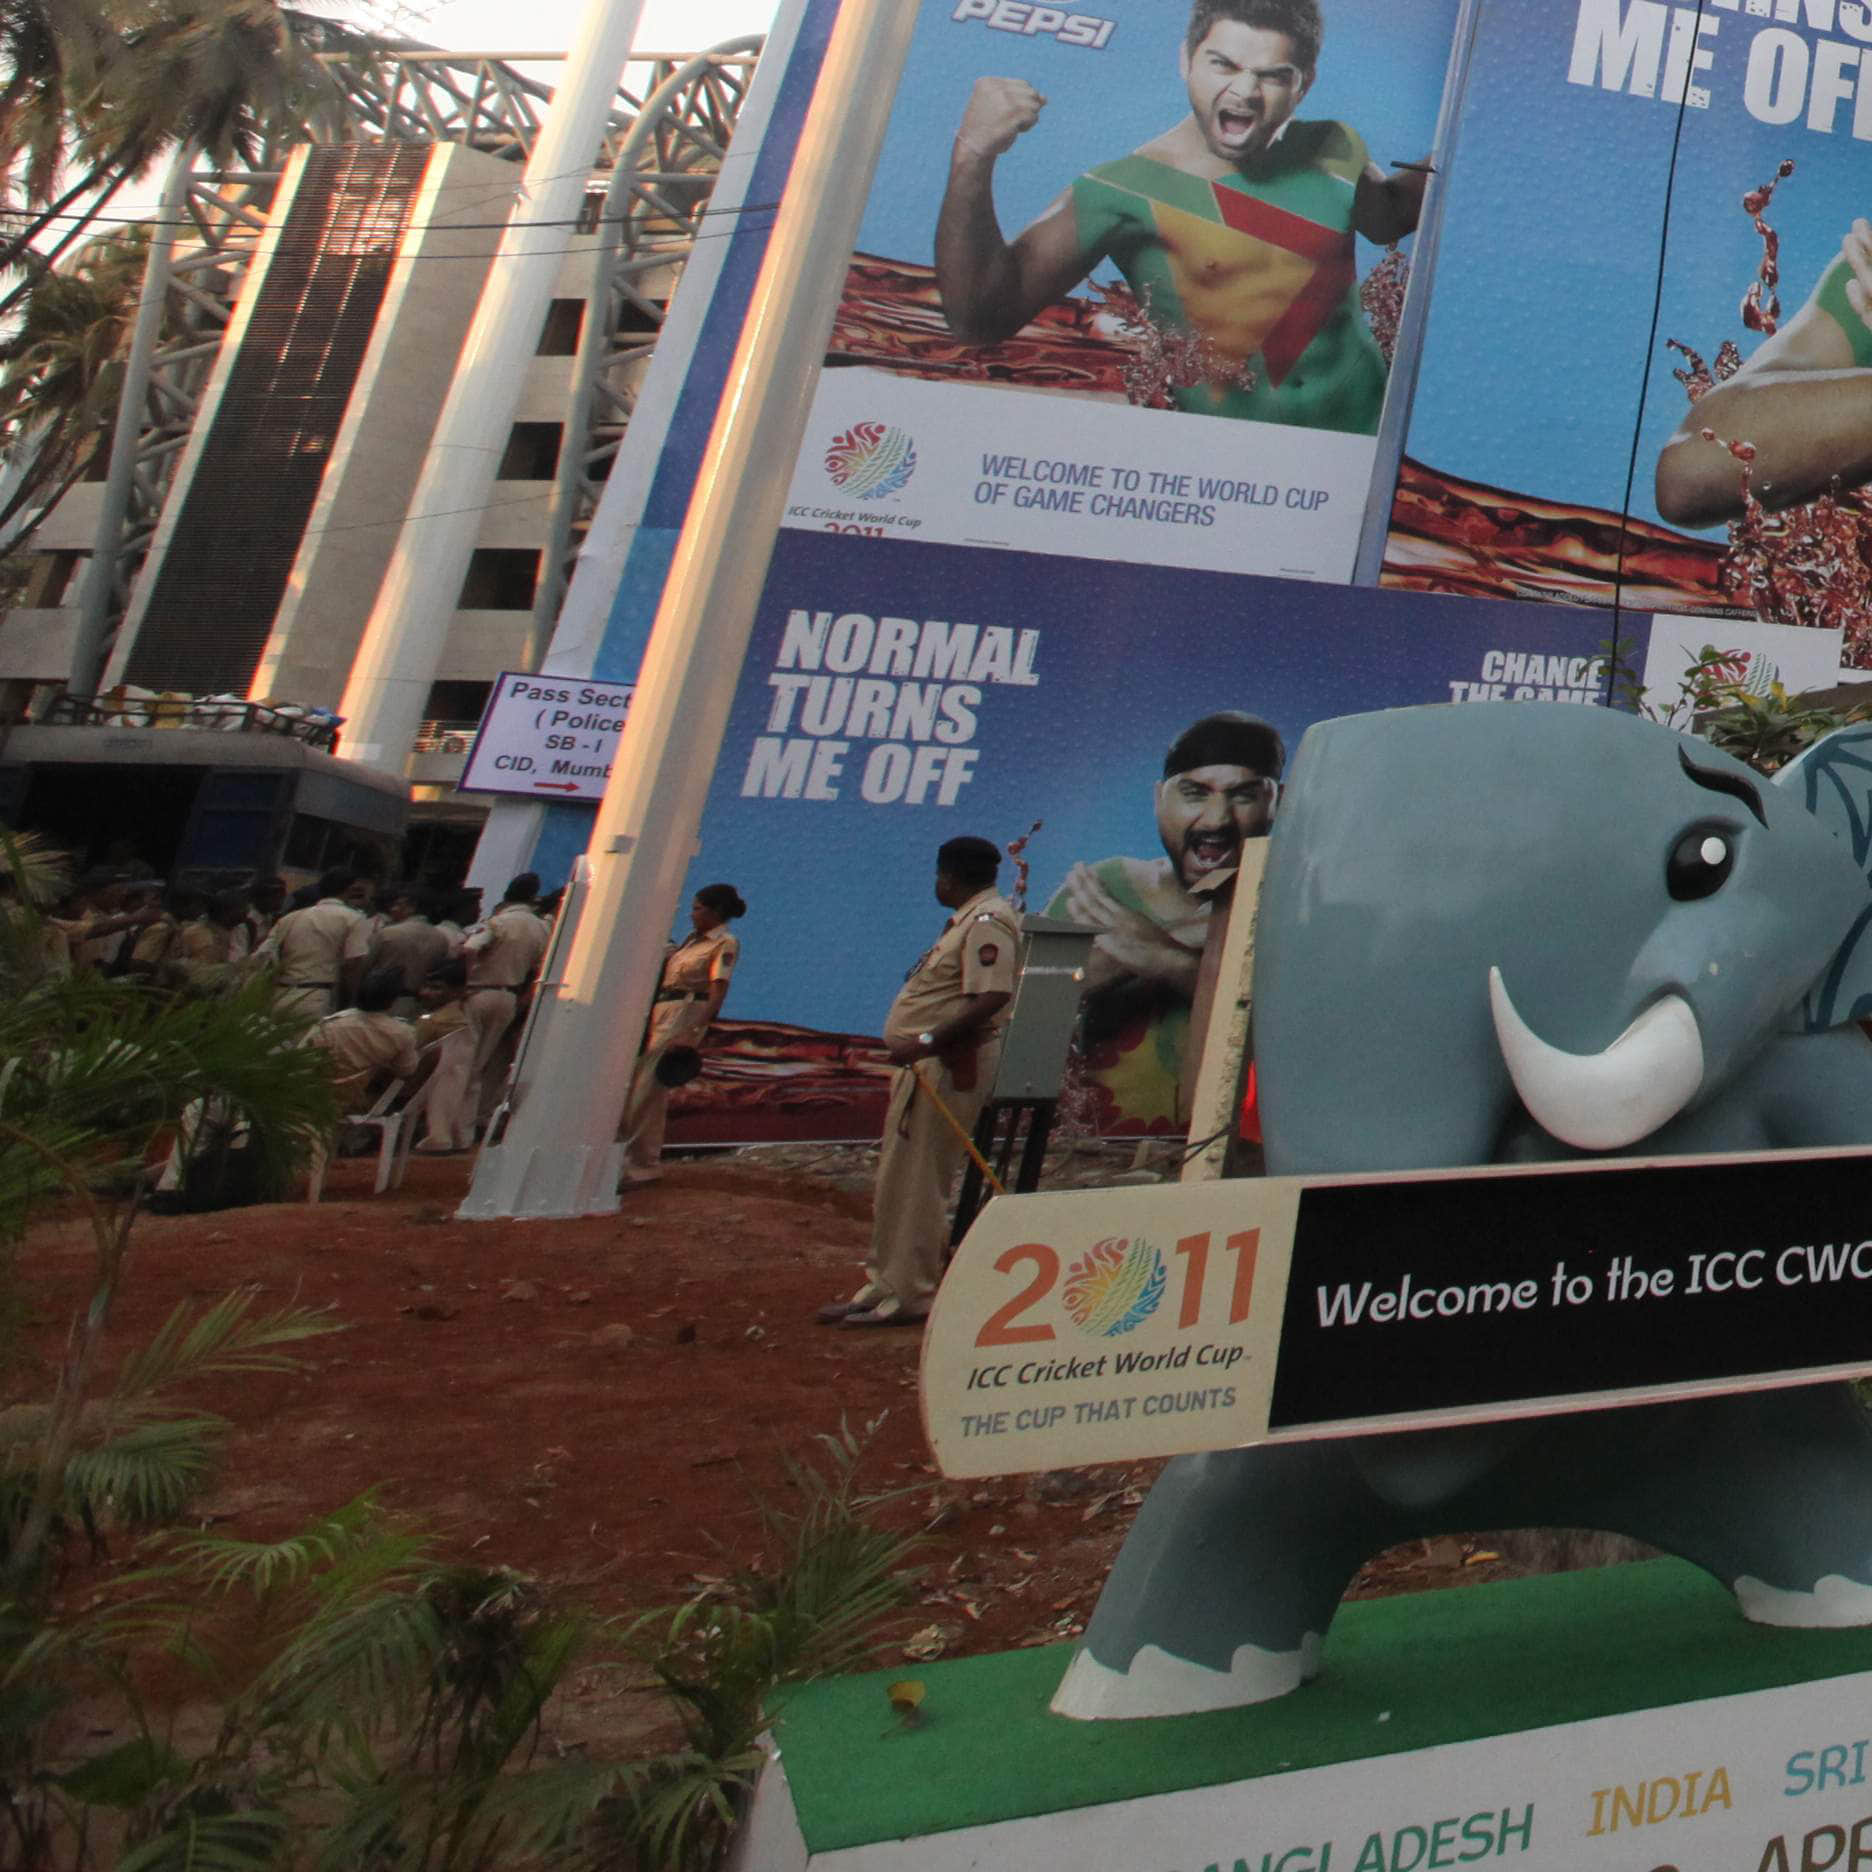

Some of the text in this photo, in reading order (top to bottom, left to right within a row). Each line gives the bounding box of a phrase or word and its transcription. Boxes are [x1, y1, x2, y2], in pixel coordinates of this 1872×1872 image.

[973, 482, 1217, 527] OF GAME CHANGERS
[981, 453, 1330, 512] WELCOME TO THE WORLD CUP
[788, 505, 922, 528] ICC Cricket World Cup
[775, 609, 1041, 687] NORMAL
[1481, 650, 1606, 689] CHANGE
[510, 682, 570, 703] Pass
[767, 672, 983, 744] TURNS
[545, 734, 576, 750] SB
[551, 710, 626, 732] Police
[494, 755, 537, 774] CID,
[740, 737, 980, 806] ME OFF
[1316, 1274, 1538, 1327] Welcome
[1551, 1260, 1594, 1306] to
[1607, 1255, 1674, 1301] the
[1684, 1250, 1764, 1296] ICC
[966, 1343, 1244, 1390] ICC Cricket World Cup
[960, 1386, 1237, 1437] THE CUP THAT COUNTS
[1166, 1803, 1535, 1872] GLADESH
[1585, 1766, 1733, 1837] INDIA
[1783, 1739, 1870, 1797] SRI
